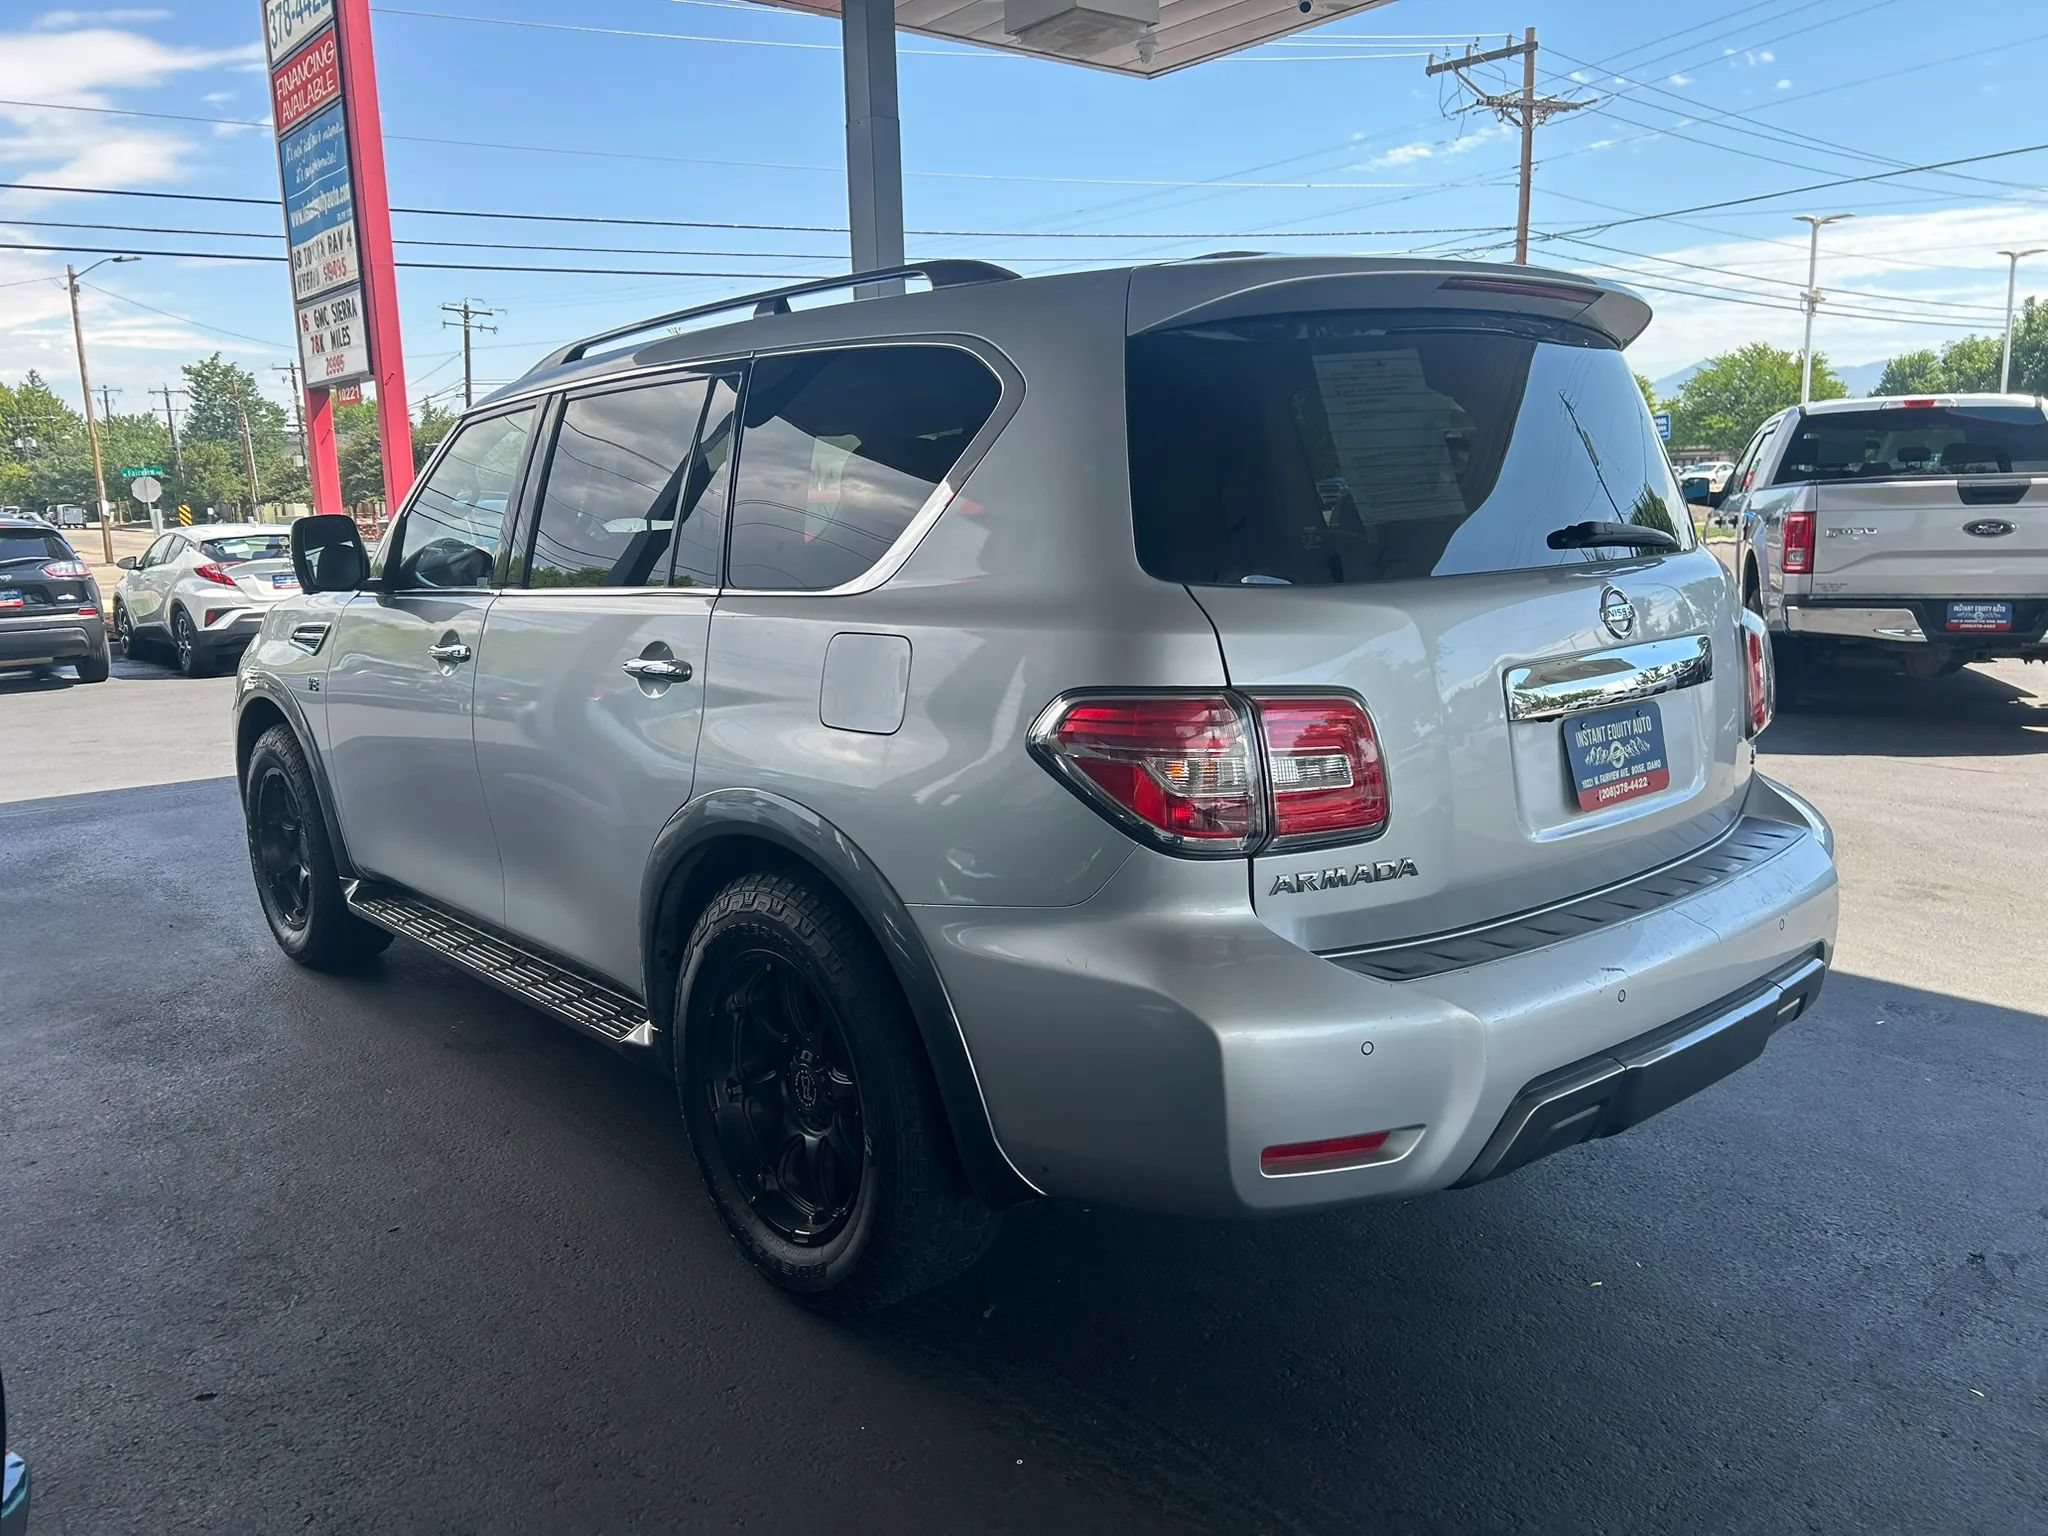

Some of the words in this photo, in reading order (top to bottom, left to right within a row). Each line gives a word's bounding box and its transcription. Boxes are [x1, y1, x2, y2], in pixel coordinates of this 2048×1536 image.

[276, 40, 335, 100] FINANCING
[282, 69, 335, 123] AVAILABLE
[327, 229, 343, 255] RAV
[347, 225, 352, 247] 4
[313, 306, 330, 328] GMC
[331, 297, 358, 324] SIERRA
[310, 334, 325, 354] 78K
[330, 325, 351, 350] MILES
[338, 386, 360, 401] 10221
[1575, 726, 1606, 748] INSTANT
[1607, 720, 1632, 740] EQUITY
[1632, 715, 1652, 734] AUTO
[1598, 777, 1649, 802] (208)378-4422
[1269, 856, 1419, 896] ARMADA
